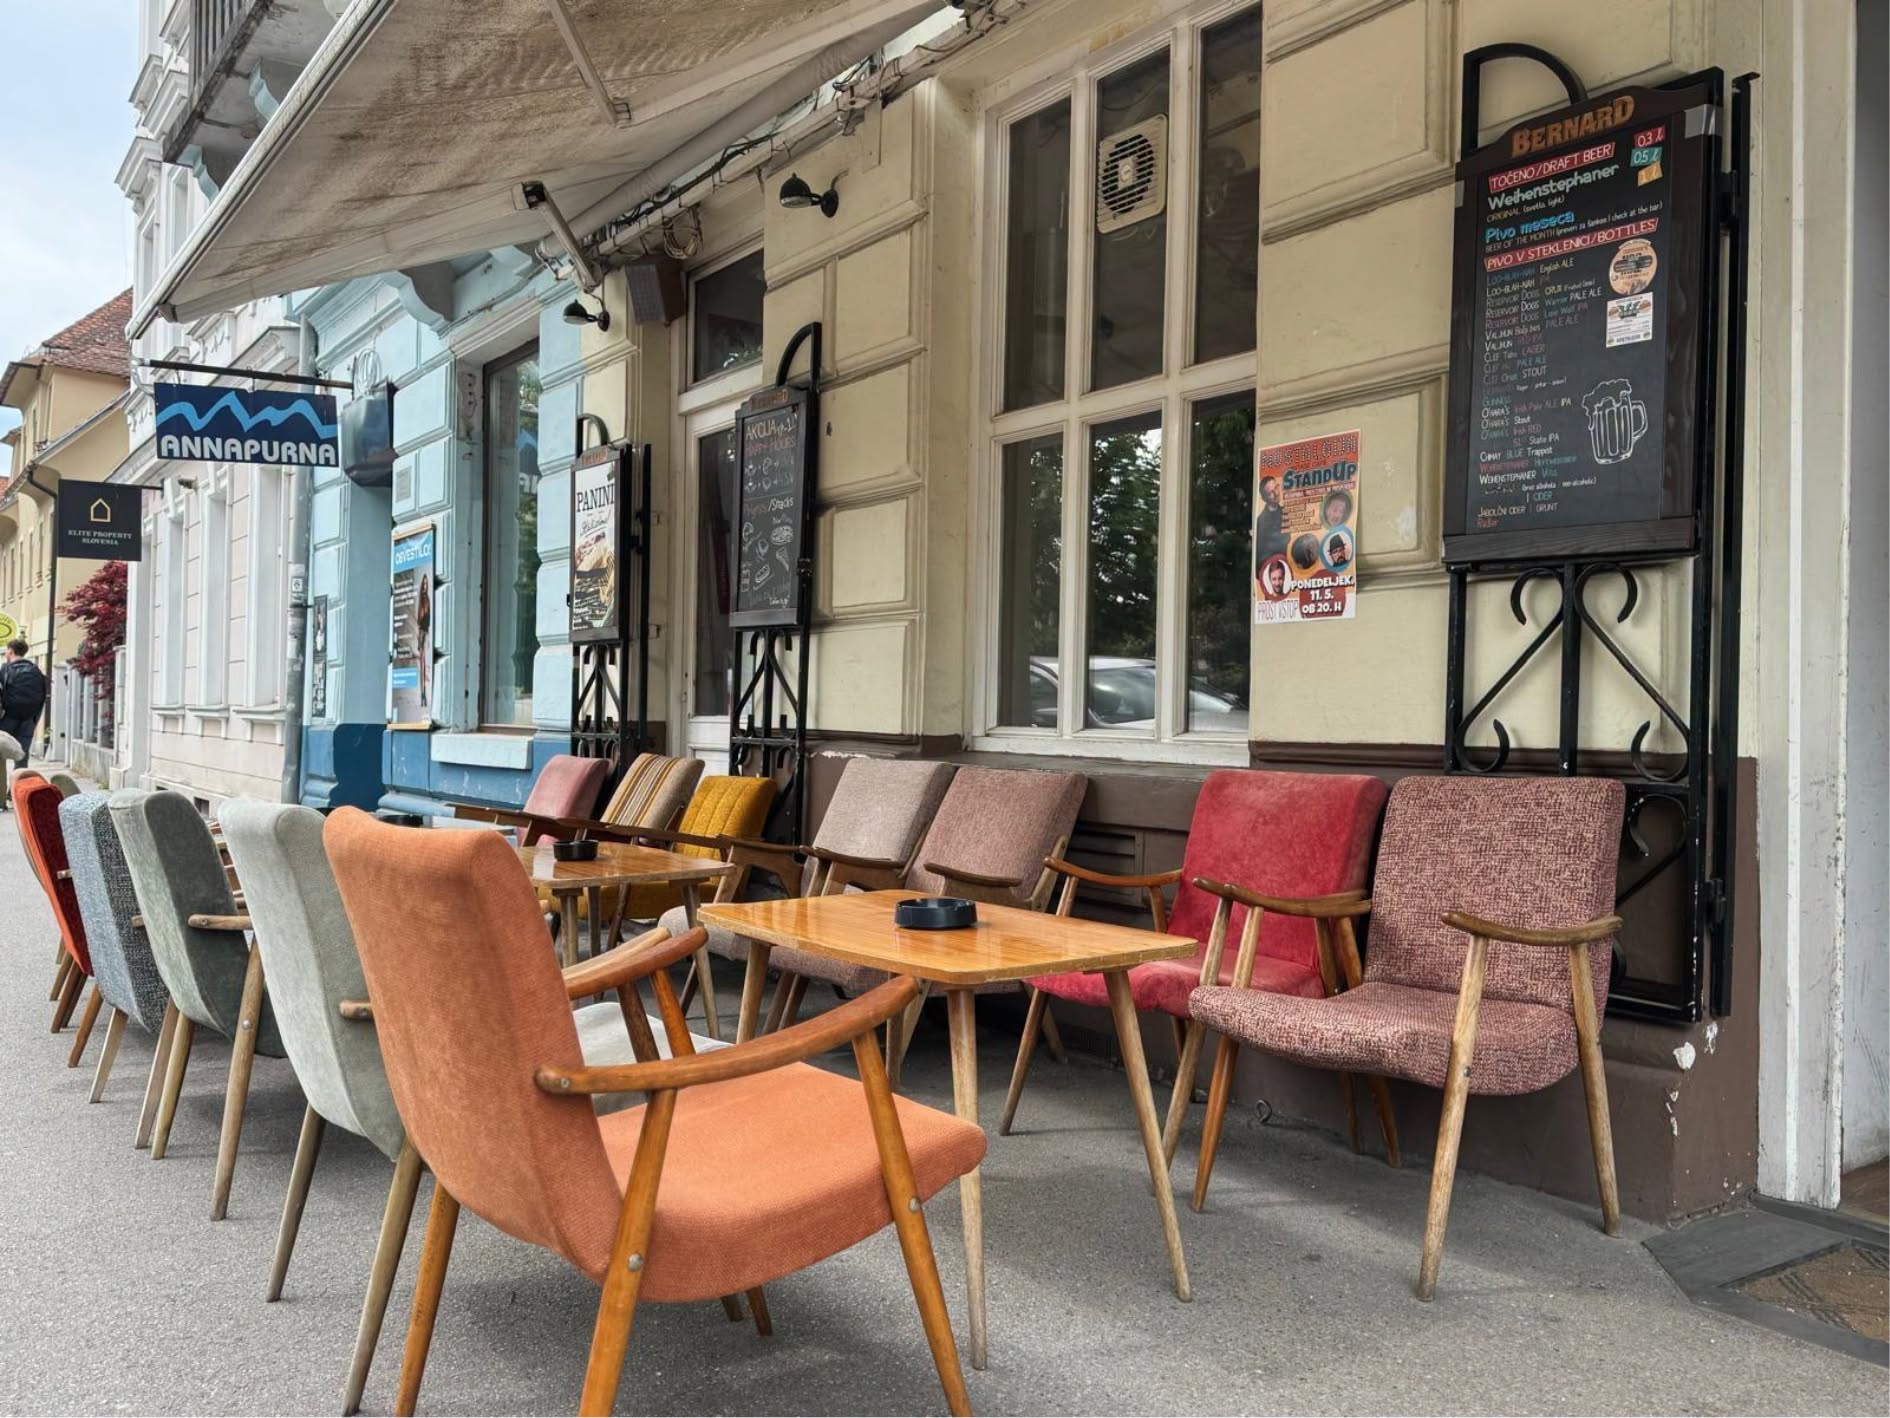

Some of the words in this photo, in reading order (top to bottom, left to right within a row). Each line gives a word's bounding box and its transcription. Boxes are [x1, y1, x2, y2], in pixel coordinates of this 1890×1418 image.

[1511, 95, 1635, 159] BERNARD
[1583, 143, 1611, 162] BEER
[1488, 164, 1620, 211] Weihenstephaner
[1485, 226, 1516, 243] Pivo
[1520, 211, 1575, 234] meseca
[1487, 254, 1513, 269] PIVO
[1561, 257, 1575, 267] ALE
[160, 433, 337, 465] ANNAPURNA
[576, 483, 615, 512] PANINI
[1325, 588, 1334, 600] 5.
[1302, 604, 1316, 614] OB
[1334, 601, 1342, 612] H
